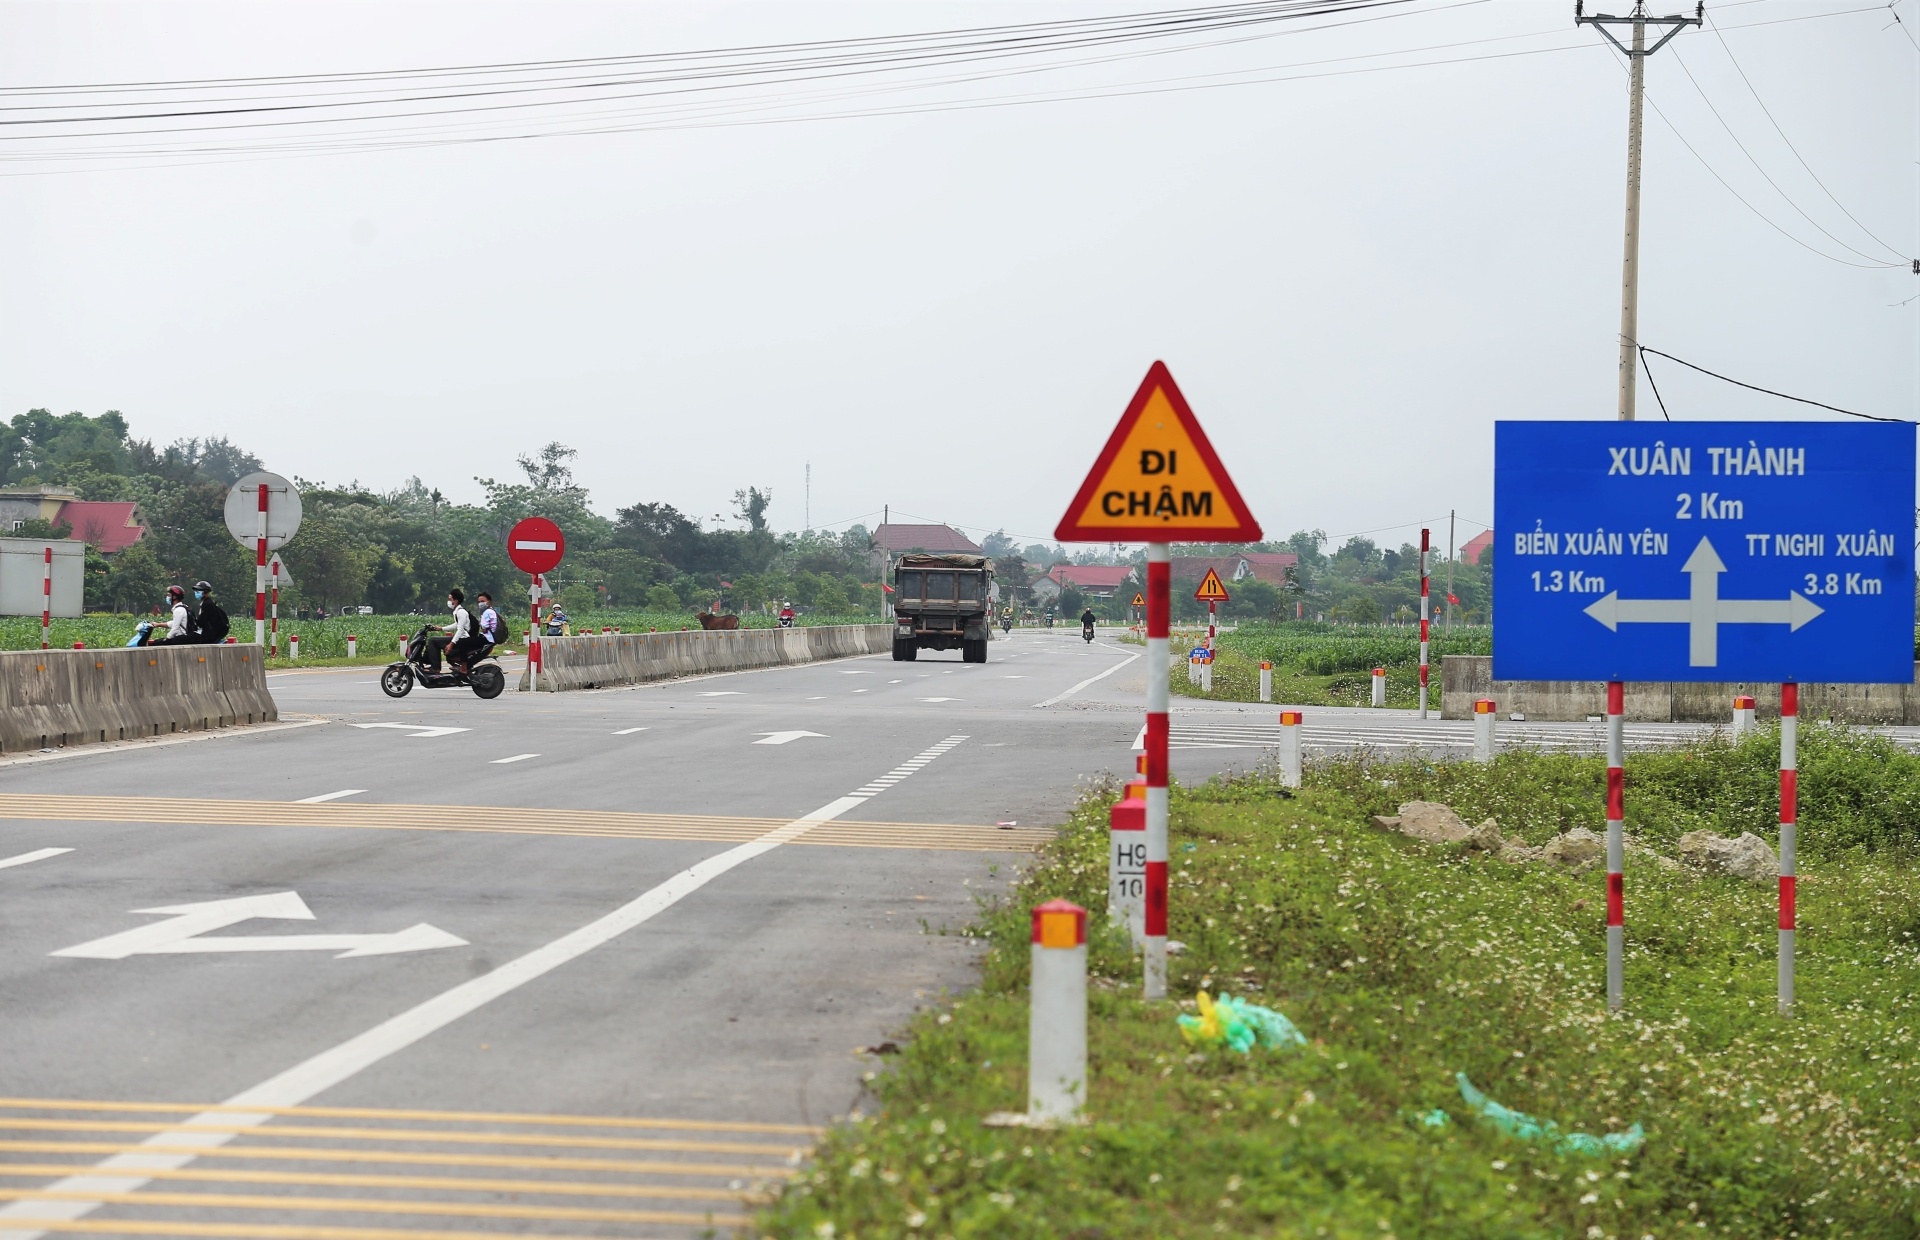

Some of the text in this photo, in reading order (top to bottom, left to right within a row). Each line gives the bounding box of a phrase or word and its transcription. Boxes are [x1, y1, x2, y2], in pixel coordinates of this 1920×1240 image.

[1139, 450, 1176, 475] ĐI
[1608, 440, 1805, 476] XUÂN THÀNH
[1102, 485, 1212, 521] CHẬM
[1676, 492, 1743, 520] 2 Km
[1515, 519, 1668, 556] BIỂN XUÂN YÊN
[1745, 529, 1894, 557] TT NGHI XUÂN
[1531, 570, 1605, 593] 1.3 Km
[1804, 573, 1882, 595] 3.8 Km
[1118, 845, 1145, 867] H9
[1119, 879, 1143, 899] 10
